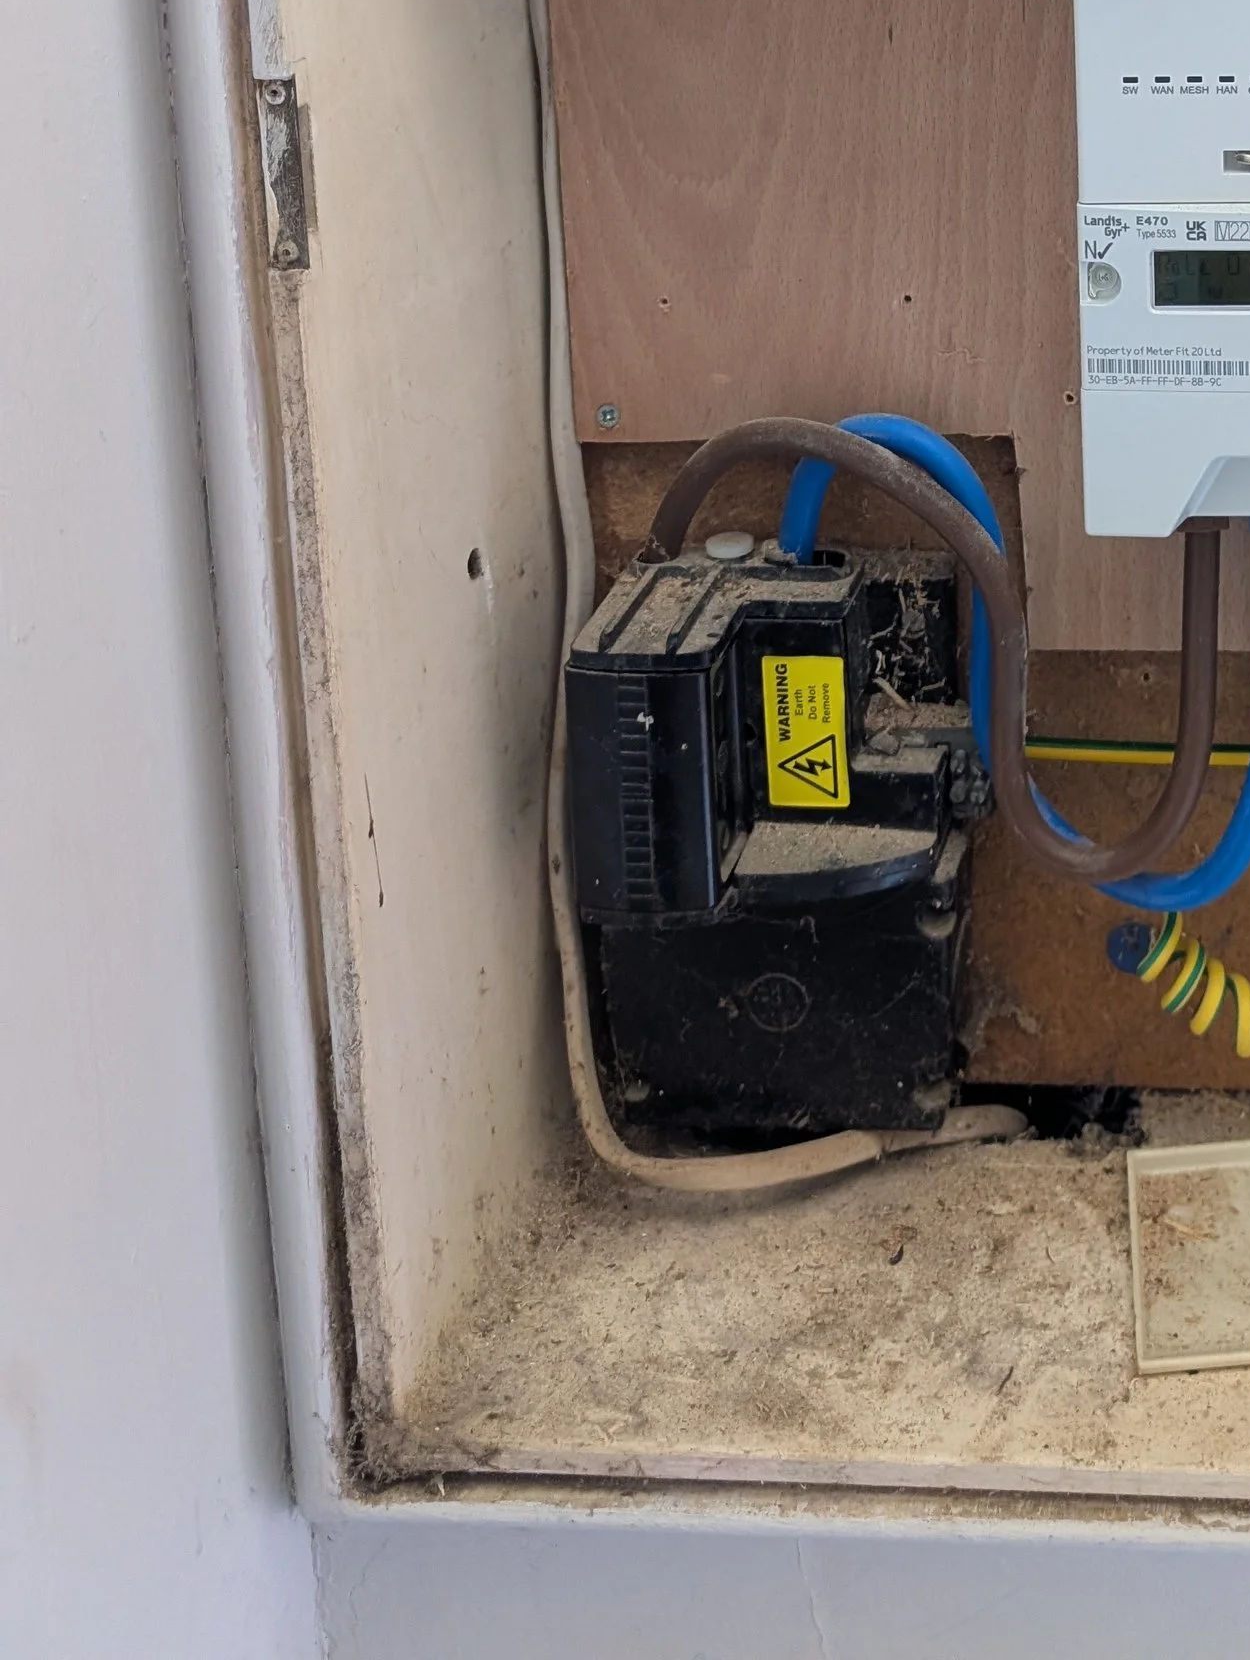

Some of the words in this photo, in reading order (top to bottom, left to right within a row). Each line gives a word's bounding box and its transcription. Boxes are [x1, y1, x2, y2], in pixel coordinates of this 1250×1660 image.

[1151, 86, 1174, 94] WAN
[1180, 86, 1209, 94] MESH
[1216, 86, 1238, 94] HAN
[1084, 216, 1122, 226] Landis
[1136, 216, 1168, 225] E470
[1137, 230, 1155, 239] Type
[1157, 230, 1176, 238] 5533
[1085, 241, 1096, 259] N
[1087, 346, 1131, 357] Property
[1134, 347, 1144, 356] of
[1147, 347, 1174, 356] Meter
[1176, 347, 1189, 356] Fit
[1192, 347, 1203, 356] 20
[1205, 348, 1221, 356] Ltd
[775, 663, 791, 742] WARNING
[795, 689, 803, 716] Earth
[808, 685, 817, 706] Not
[822, 683, 830, 723] Remove
[808, 708, 817, 720] Do
